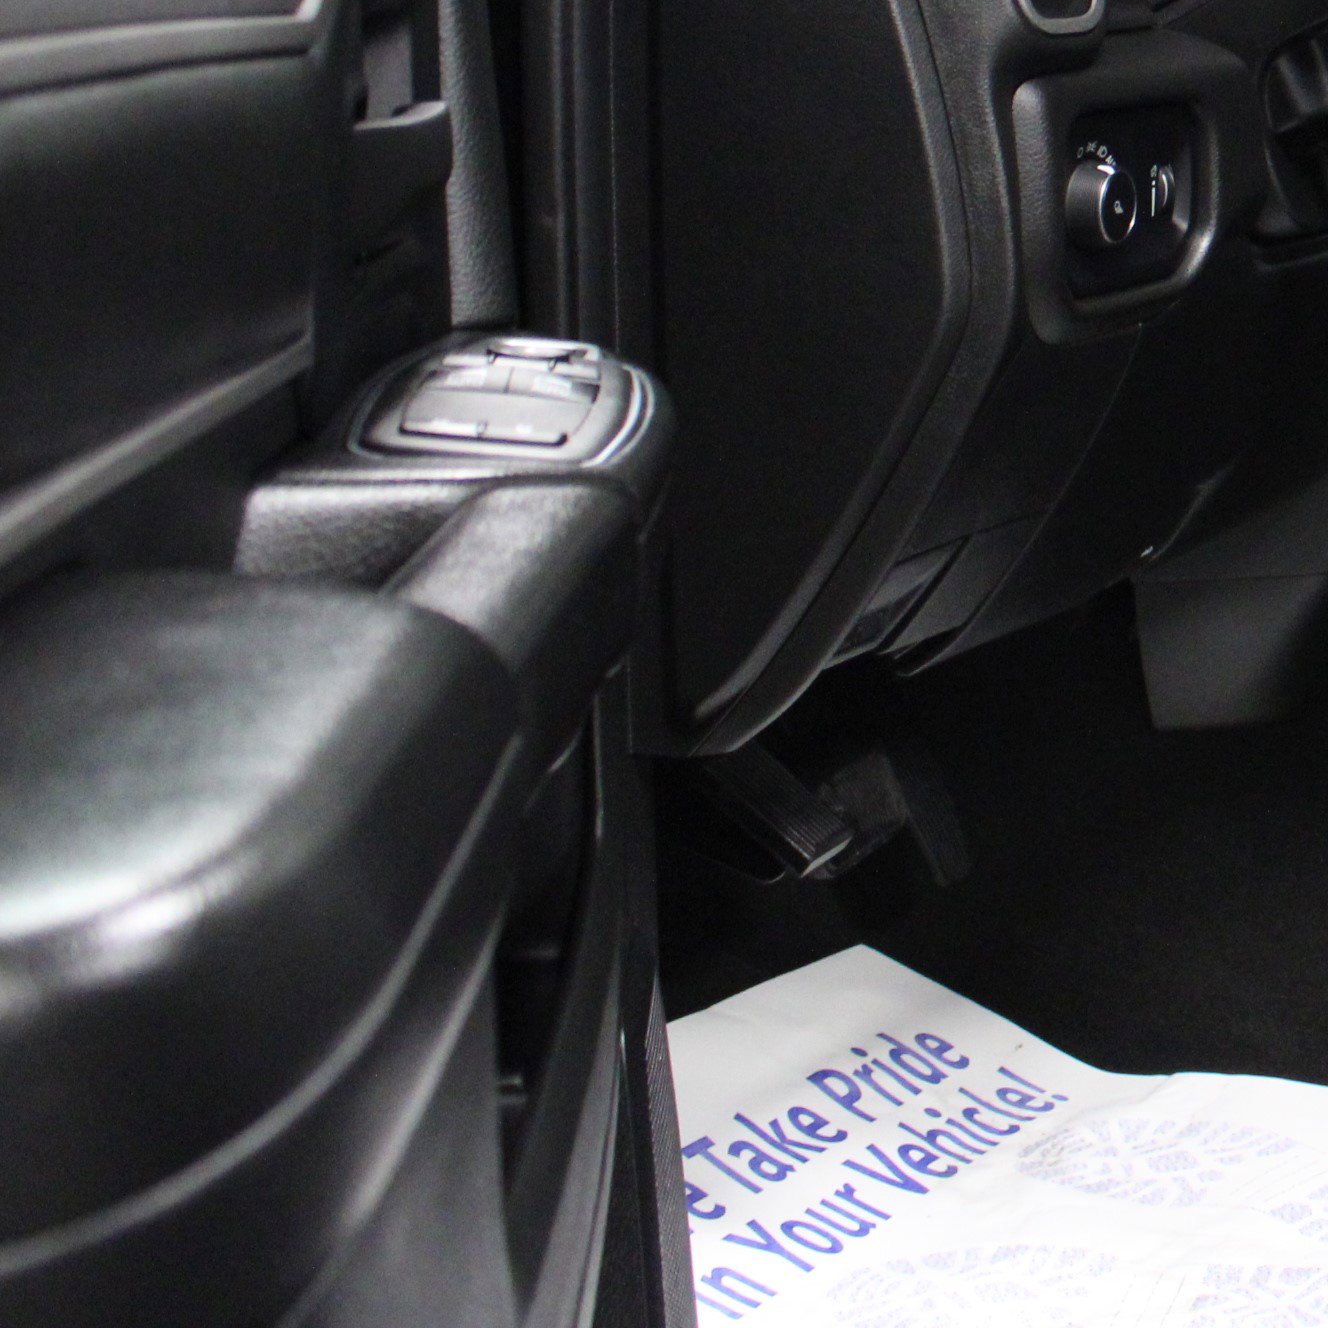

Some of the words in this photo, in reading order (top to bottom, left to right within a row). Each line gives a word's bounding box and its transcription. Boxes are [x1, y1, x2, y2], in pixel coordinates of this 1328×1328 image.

[805, 1032, 970, 1123] Pride
[682, 1104, 848, 1194] Take
[722, 1182, 892, 1273] Your
[842, 1066, 1069, 1195] Vehicle!
[684, 1182, 726, 1230] e
